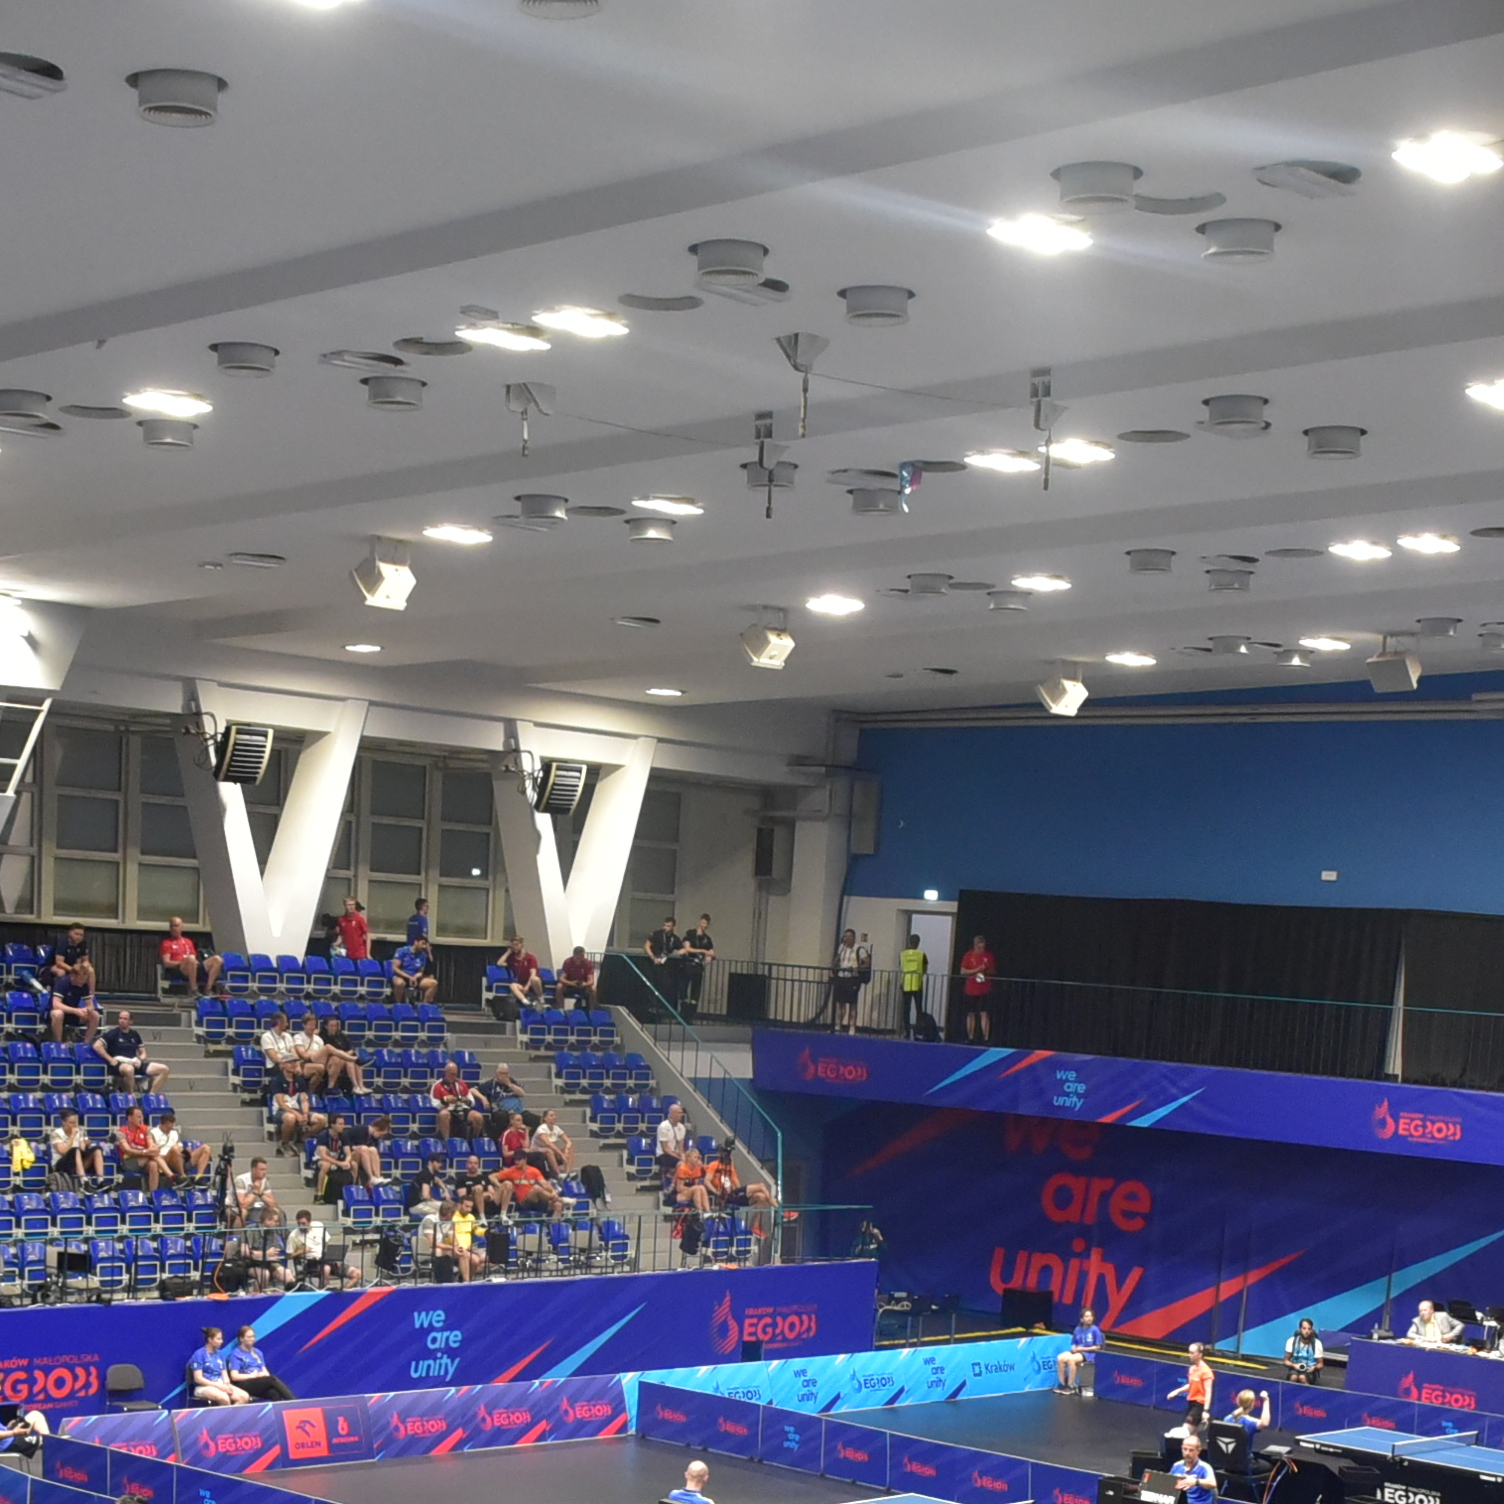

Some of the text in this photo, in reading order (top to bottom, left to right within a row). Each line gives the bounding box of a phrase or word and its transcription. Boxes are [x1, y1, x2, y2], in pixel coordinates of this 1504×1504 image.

[1056, 1069, 1077, 1082] we
[1064, 1080, 1086, 1093] are
[1053, 1094, 1084, 1111] unity
[1398, 1117, 1462, 1141] EG2023
[1004, 1115, 1100, 1160] we
[1042, 1172, 1153, 1232] are
[990, 1237, 1144, 1330] unity
[414, 1310, 445, 1328] we
[742, 1313, 817, 1341] EG2023
[427, 1329, 462, 1349] are
[410, 1355, 460, 1381] unity
[922, 1356, 936, 1365] we
[985, 1359, 1015, 1374] Kraków
[793, 1367, 807, 1378] we
[931, 1365, 945, 1375] are
[801, 1377, 818, 1389] are
[863, 1374, 895, 1389] EG2023
[926, 1376, 946, 1390] unity
[797, 1389, 818, 1404] unity
[1421, 1387, 1477, 1410] EG2023
[493, 1411, 532, 1427] EG2023
[575, 1403, 612, 1419] EG2023
[407, 1417, 447, 1434] EG2023
[217, 1435, 263, 1452] EG2023
[294, 1440, 322, 1451] ORLEN
[199, 1489, 211, 1498] we
